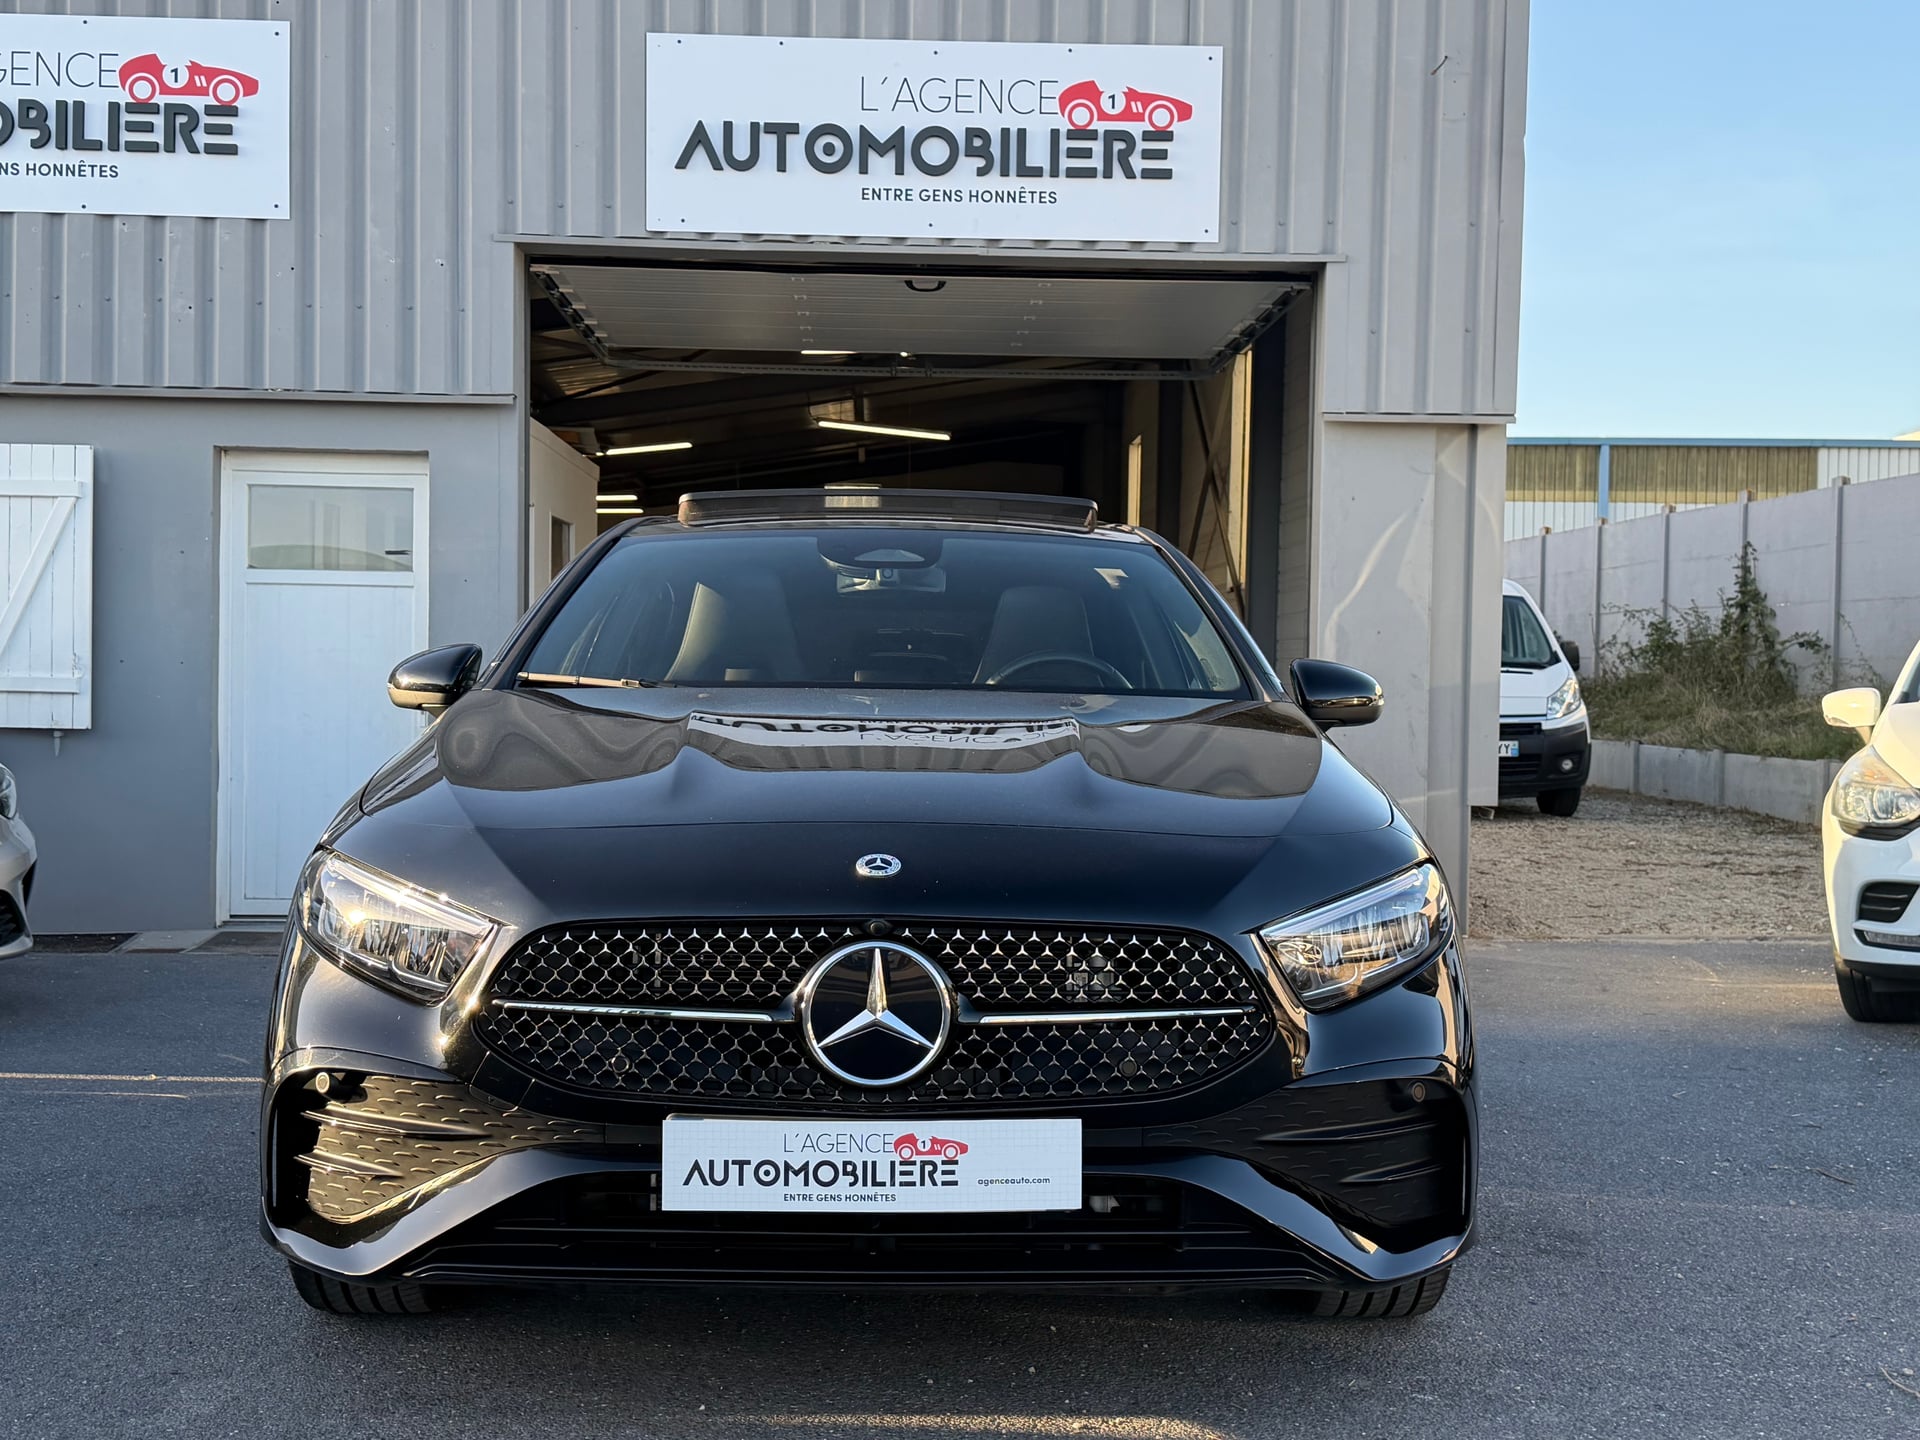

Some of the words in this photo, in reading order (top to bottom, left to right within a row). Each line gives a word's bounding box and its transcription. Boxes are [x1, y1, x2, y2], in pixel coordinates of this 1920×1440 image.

[0, 51, 119, 88] ENCE
[169, 67, 180, 83] 1
[861, 76, 1058, 115] L'AGENCE
[1107, 93, 1116, 110] 1
[674, 120, 1174, 180] AUTOMOBILIERE
[26, 160, 119, 178] HONNÊTES
[861, 187, 914, 202] ENTRE
[918, 188, 963, 203] GENS
[968, 186, 1058, 204] HONNÊTES
[783, 1133, 894, 1153] L'AGENCE
[920, 1139, 926, 1150] 1
[682, 1159, 959, 1187] AUTOMOBILIERE
[977, 1176, 1051, 1187] agenceauto.com
[783, 1193, 814, 1202] ENTRE
[816, 1193, 843, 1202] GENS
[844, 1191, 897, 1202] HONNÊTES
